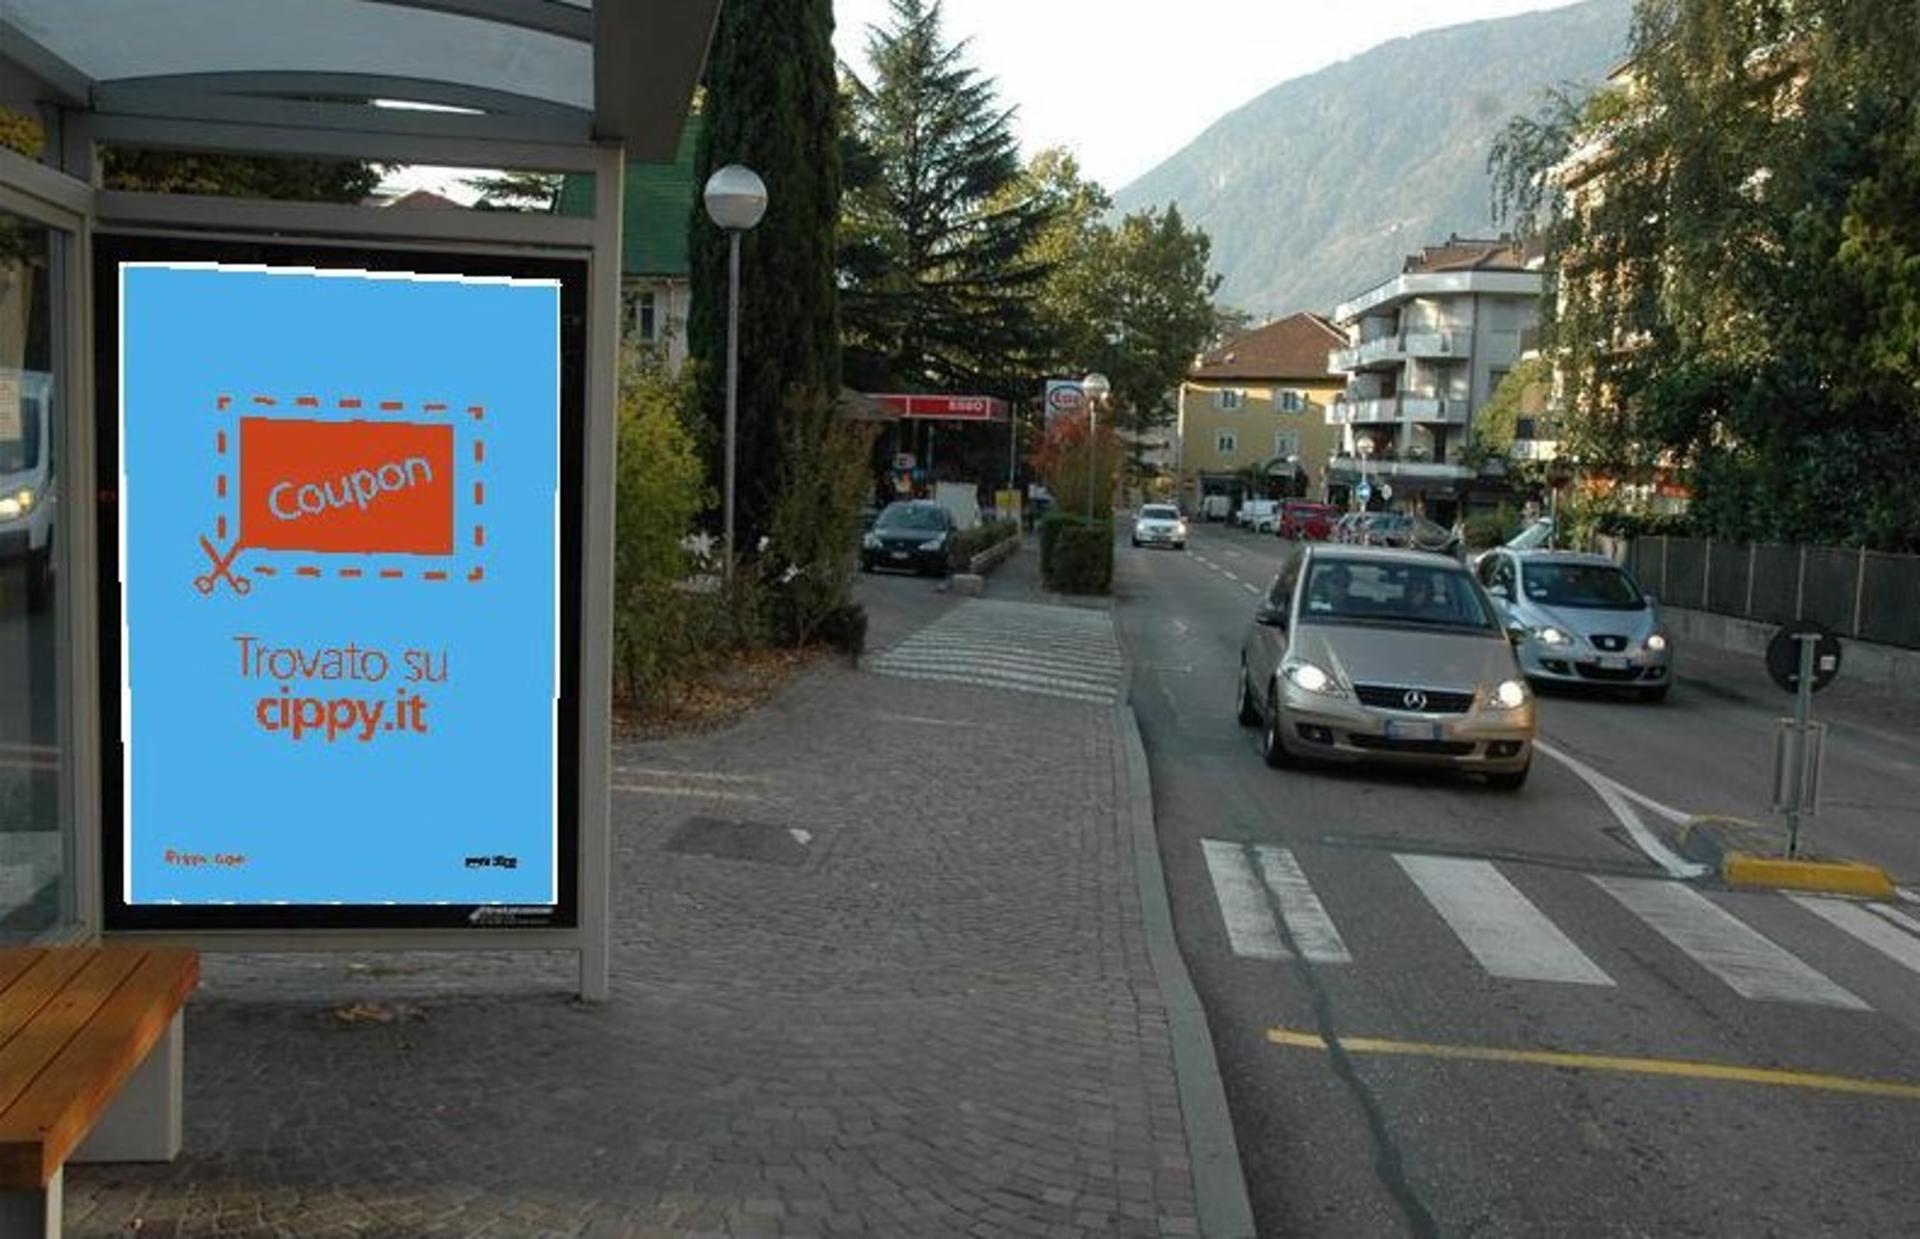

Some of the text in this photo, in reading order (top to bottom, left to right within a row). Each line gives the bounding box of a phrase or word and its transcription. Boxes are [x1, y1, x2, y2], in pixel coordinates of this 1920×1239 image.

[268, 456, 433, 521] Coupon
[233, 636, 448, 683] Trovato su
[256, 686, 428, 742] cippy.it
